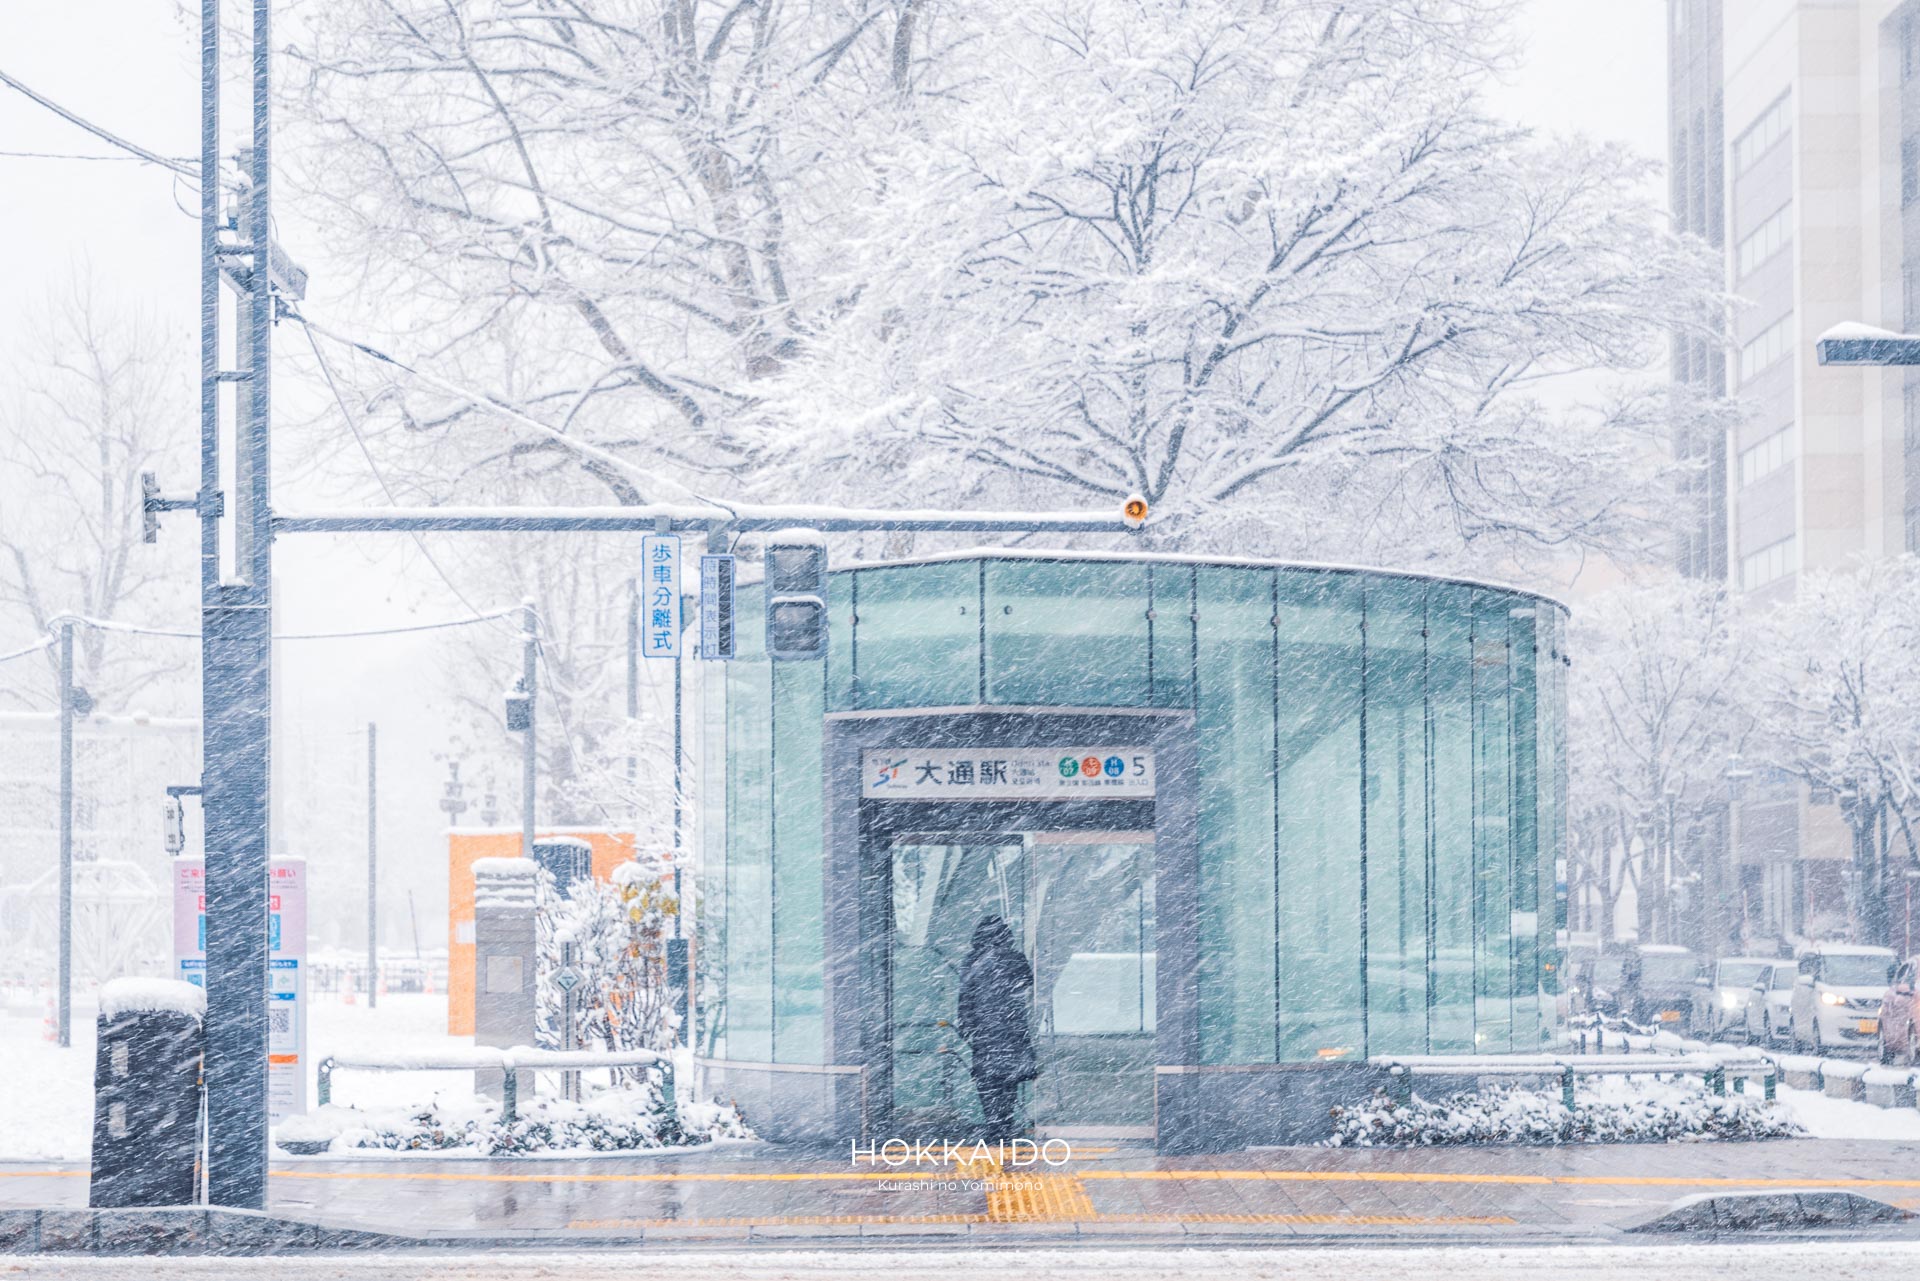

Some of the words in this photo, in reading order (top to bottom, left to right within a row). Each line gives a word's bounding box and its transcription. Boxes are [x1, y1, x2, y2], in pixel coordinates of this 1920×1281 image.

[652, 545, 672, 650] 歩車分離式
[703, 560, 717, 656] 待時間表示灯
[915, 760, 1008, 785] 大通駅
[1133, 757, 1145, 776] 5
